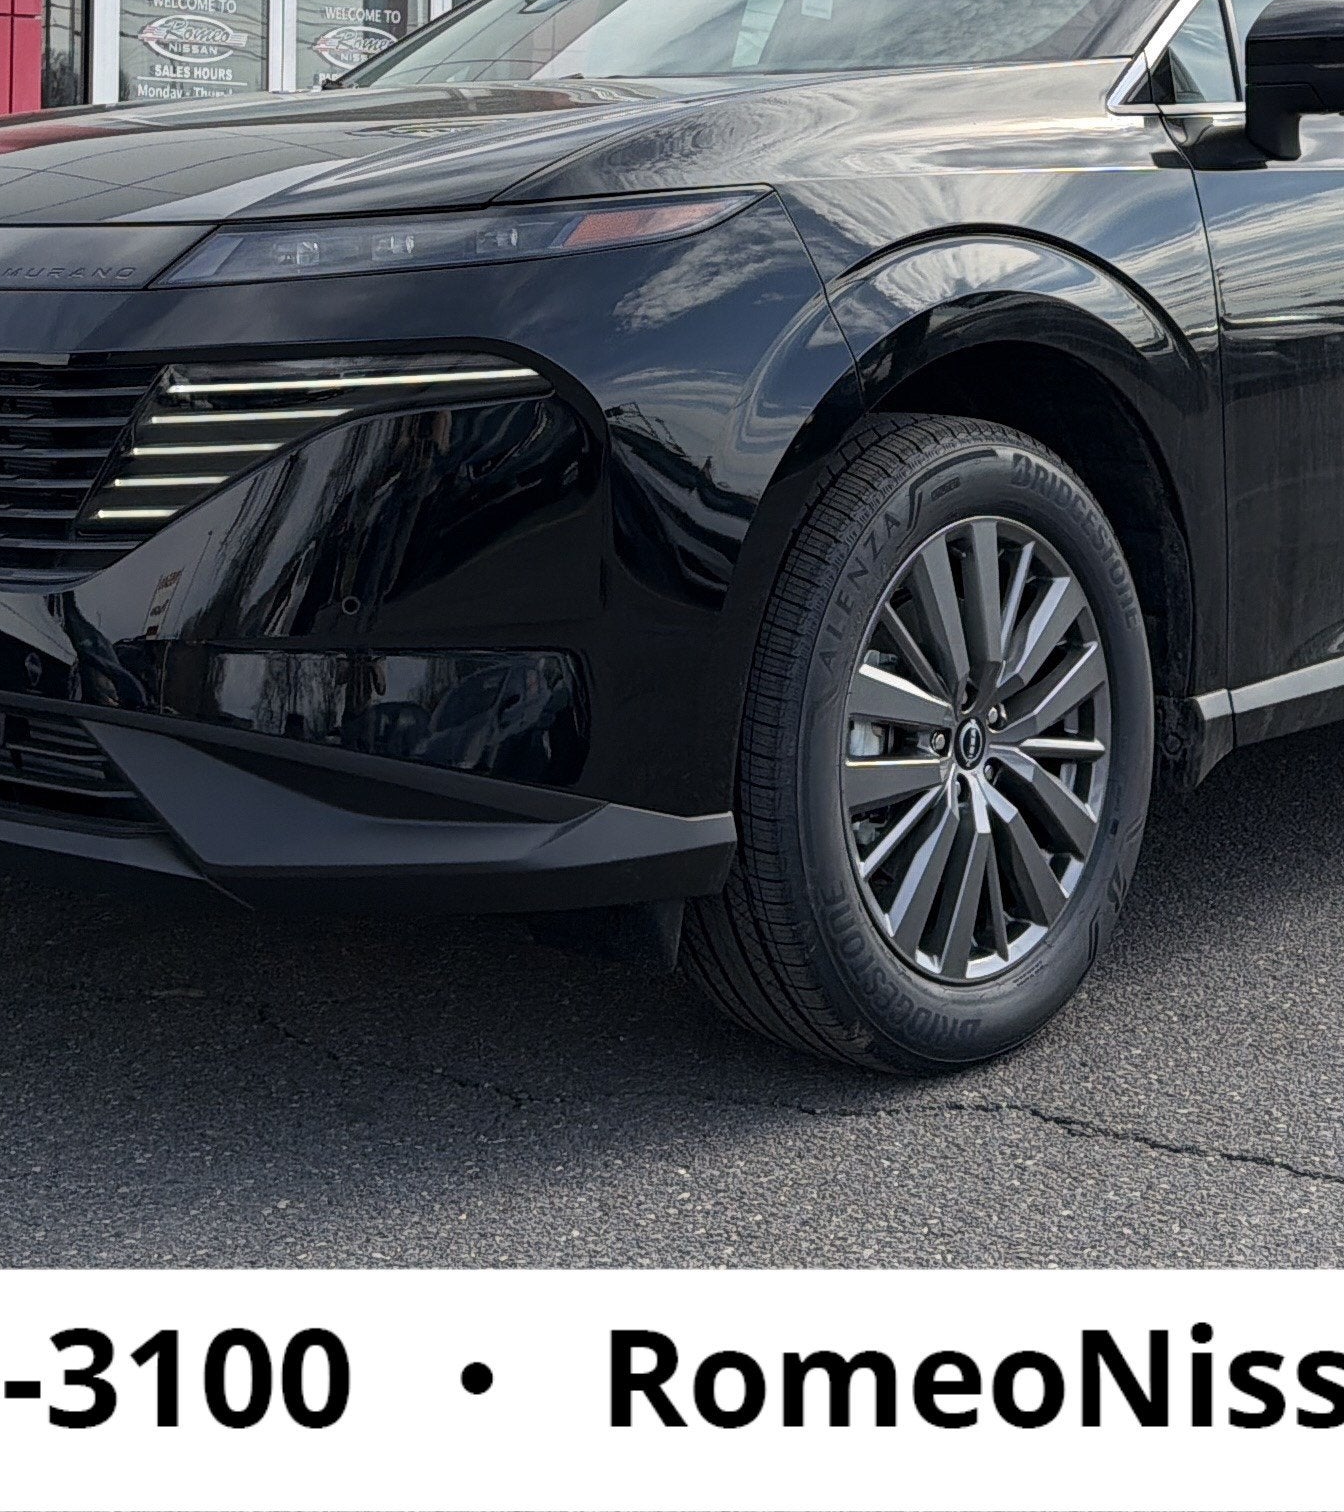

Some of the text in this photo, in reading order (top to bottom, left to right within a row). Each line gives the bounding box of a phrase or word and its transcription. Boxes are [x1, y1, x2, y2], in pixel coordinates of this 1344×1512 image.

[325, 6, 402, 24] WELCOME TO
[162, 17, 232, 43] Romeo
[168, 43, 218, 56] NISSAN
[154, 64, 233, 81] SALES HOURS
[2, 267, 138, 280] MURANO
[1012, 453, 1139, 629] BRIDGESTONE
[818, 510, 902, 675] ALENZA
